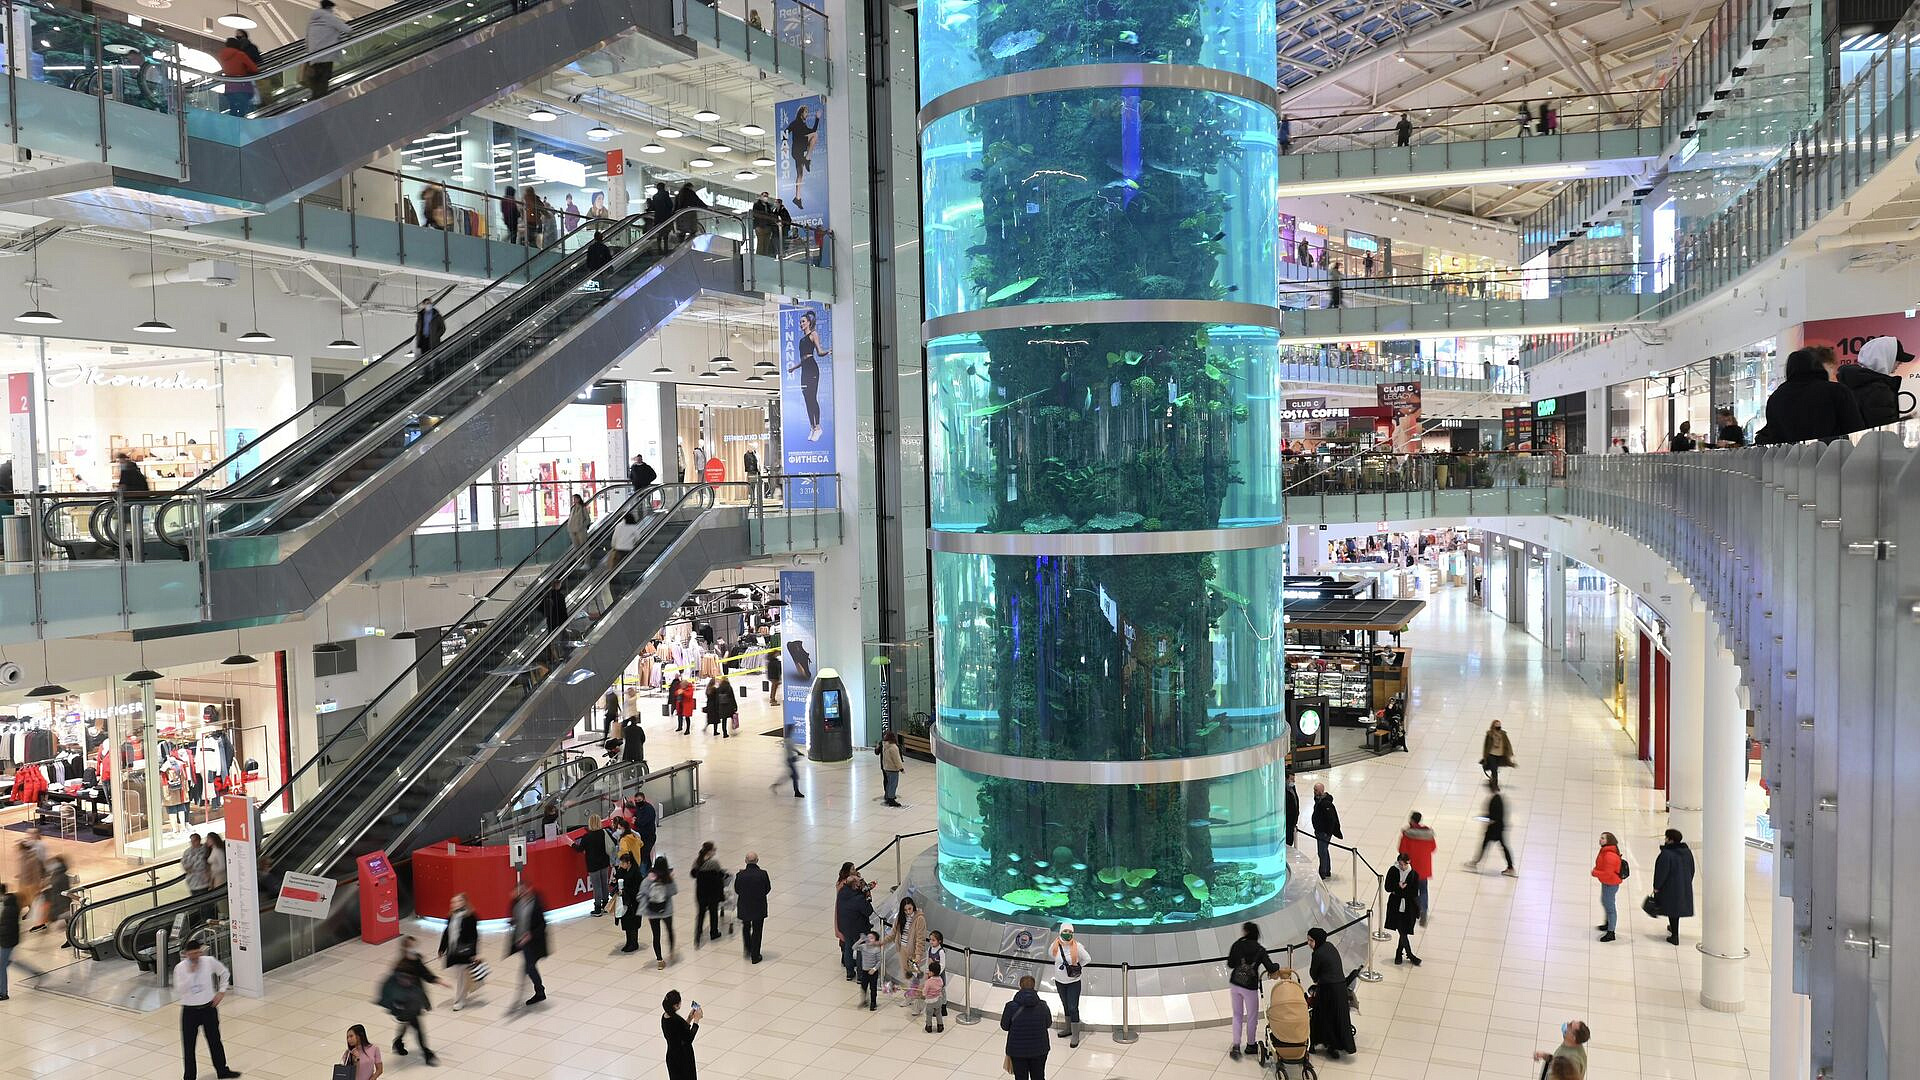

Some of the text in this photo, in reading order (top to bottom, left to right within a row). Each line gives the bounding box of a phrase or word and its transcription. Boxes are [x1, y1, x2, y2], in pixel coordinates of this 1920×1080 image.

[616, 164, 622, 174] 3
[48, 363, 222, 392] Эконика
[1384, 385, 1405, 393] CLUB
[1384, 392, 1414, 400] LEGACY
[20, 396, 28, 411] 2
[1280, 408, 1349, 419] COSTA COFFEE
[616, 418, 622, 428] 2
[788, 455, 829, 463] ФИТНЕСА
[84, 702, 144, 721] HILFIGER
[214, 770, 249, 792] SALE
[240, 823, 246, 840] 1
